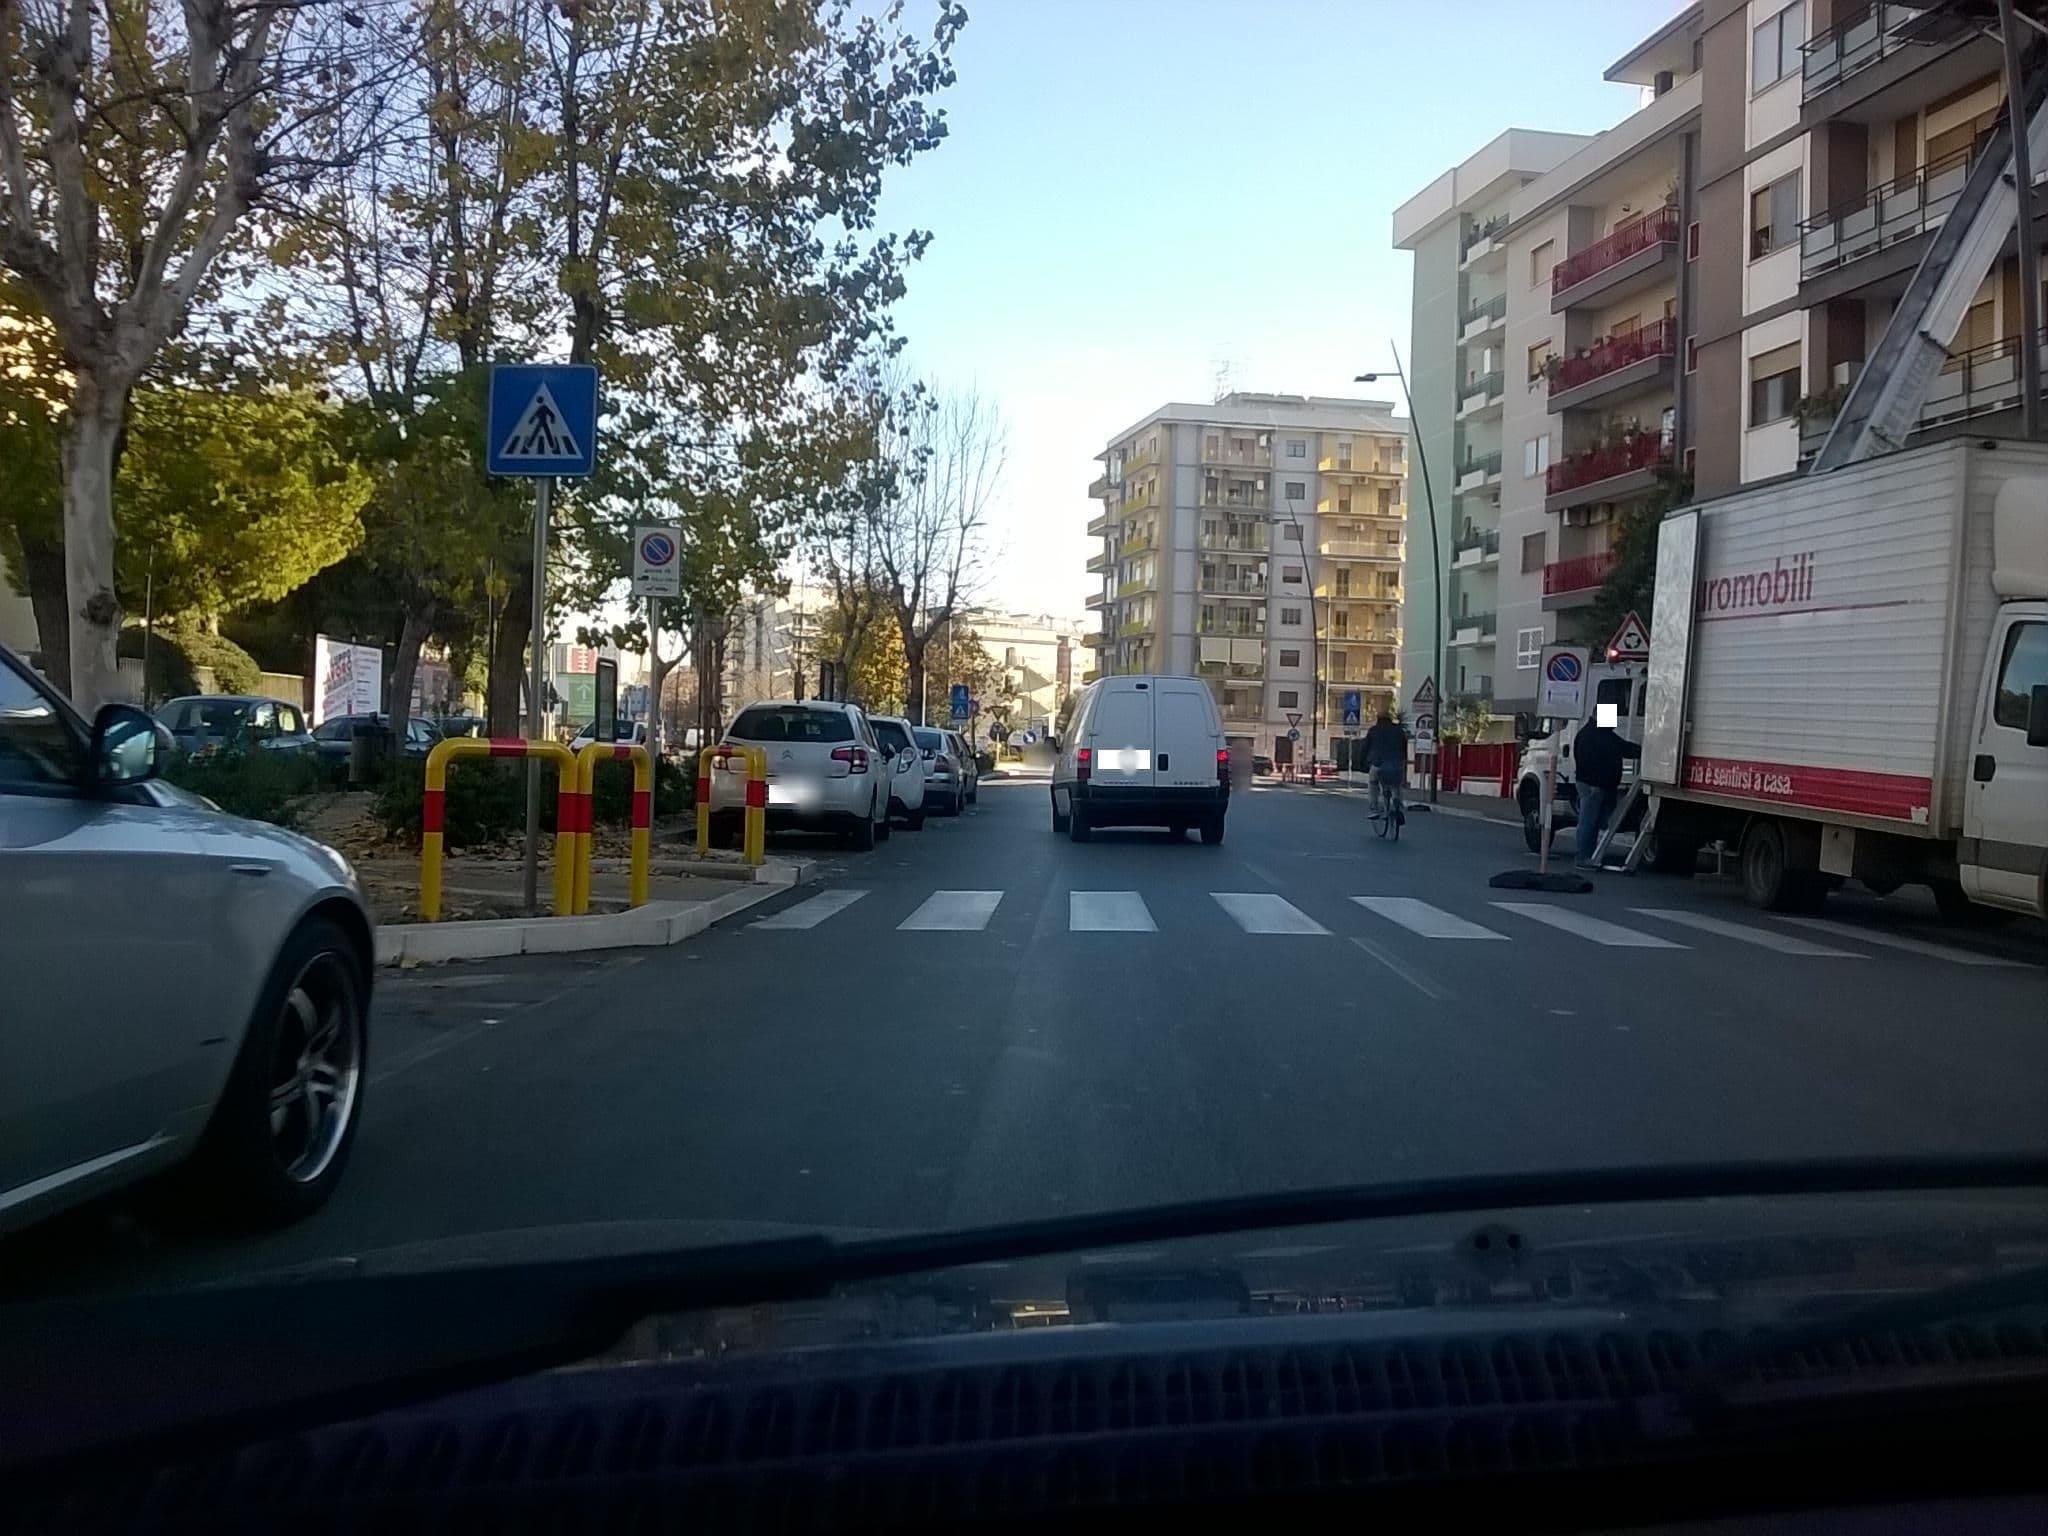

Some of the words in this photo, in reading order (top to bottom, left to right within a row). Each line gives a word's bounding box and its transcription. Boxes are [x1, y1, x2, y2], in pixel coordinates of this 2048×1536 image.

[1713, 765, 1753, 790] sentirsi
[1754, 772, 1762, 792] a
[1763, 773, 1794, 796] casa.
